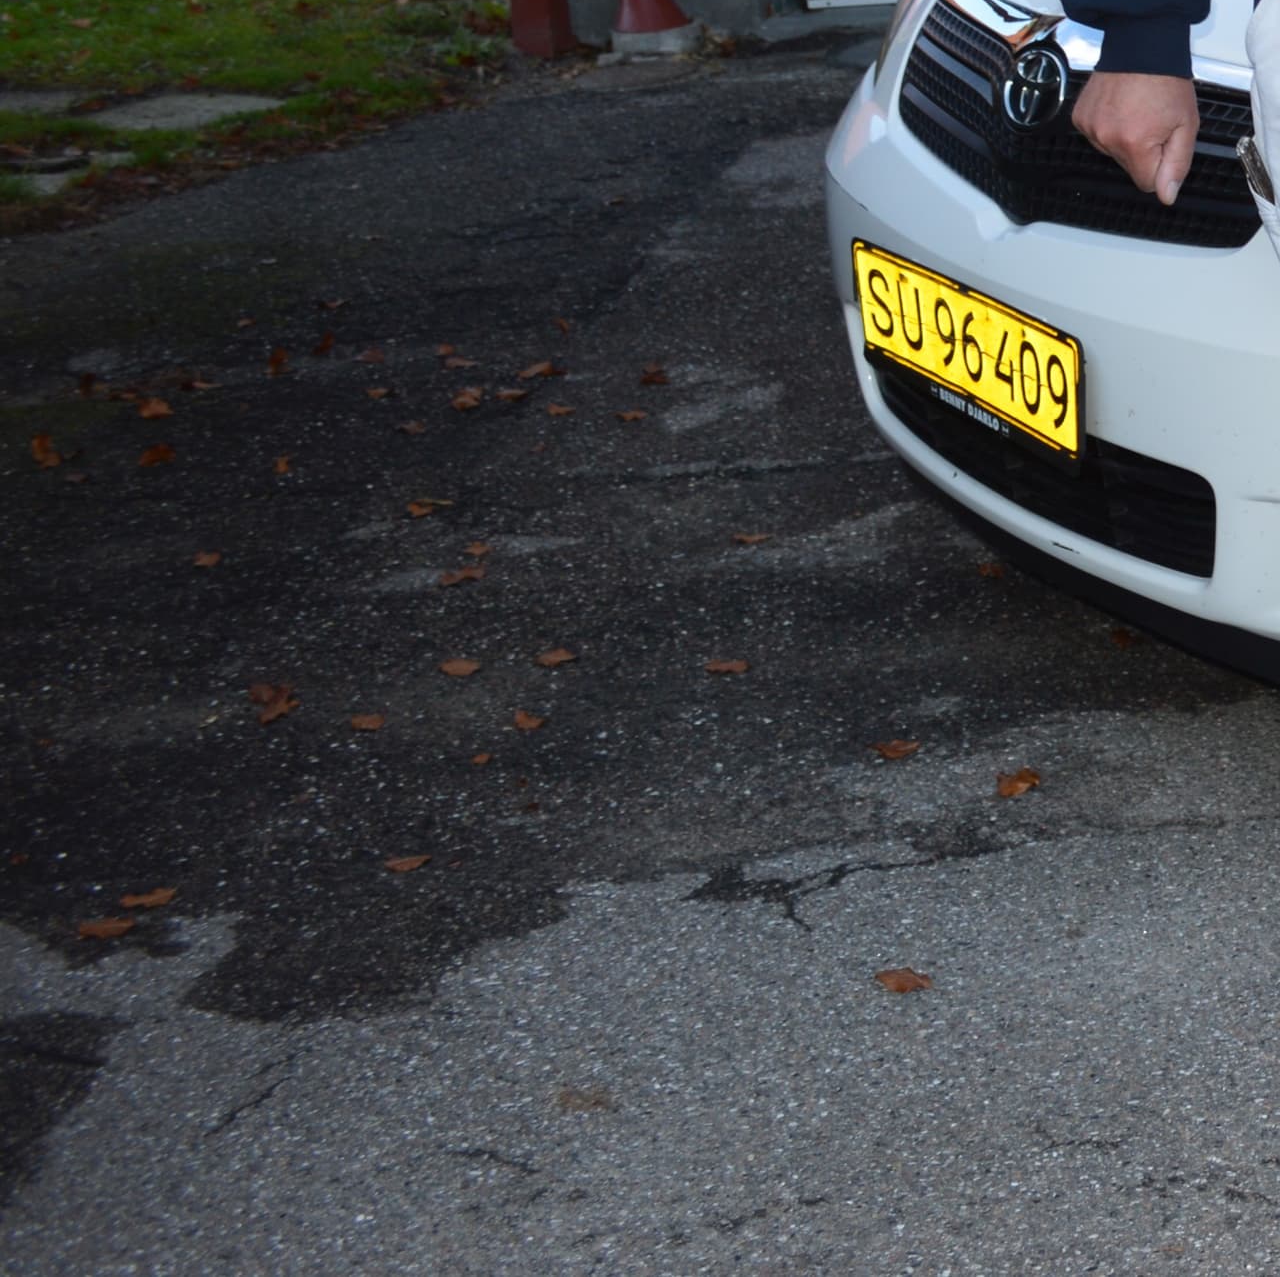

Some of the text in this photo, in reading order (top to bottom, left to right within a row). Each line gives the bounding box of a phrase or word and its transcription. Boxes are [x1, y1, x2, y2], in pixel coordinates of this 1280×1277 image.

[867, 268, 1068, 430] SU 96 409
